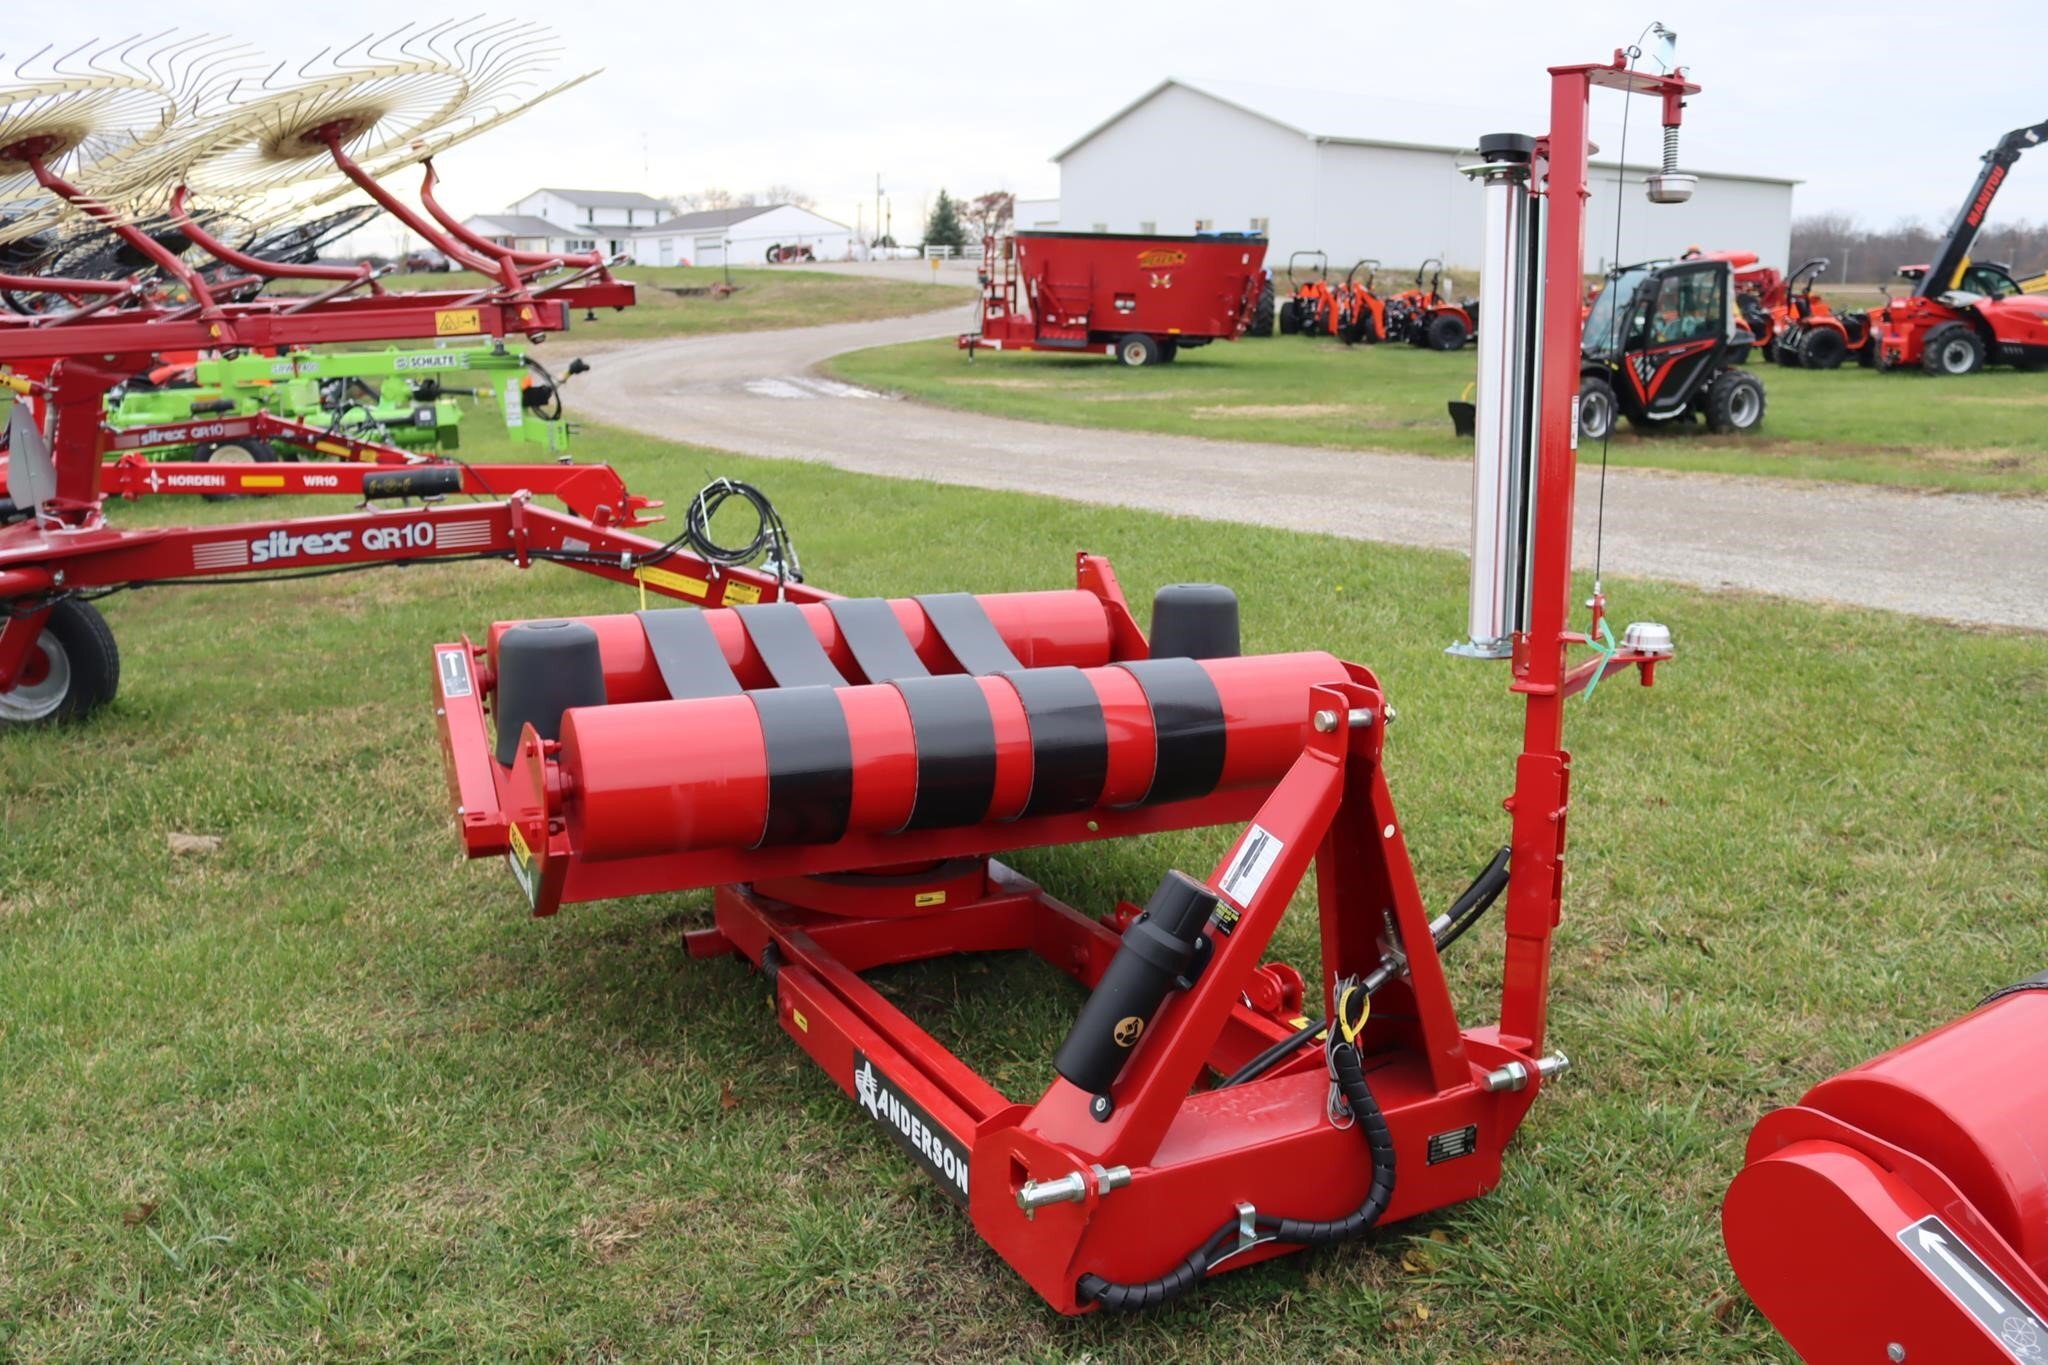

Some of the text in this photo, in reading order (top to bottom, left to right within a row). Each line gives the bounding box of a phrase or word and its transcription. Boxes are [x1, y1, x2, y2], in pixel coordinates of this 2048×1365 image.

[1967, 164, 2005, 227] MANITOU
[411, 354, 455, 368] SCHULTE
[140, 423, 224, 446] sitrex QR10
[167, 475, 220, 487] NORDEN
[303, 475, 338, 487] WR10
[251, 521, 434, 563] sitrex QR10
[876, 1087, 969, 1195] ANDERSON
